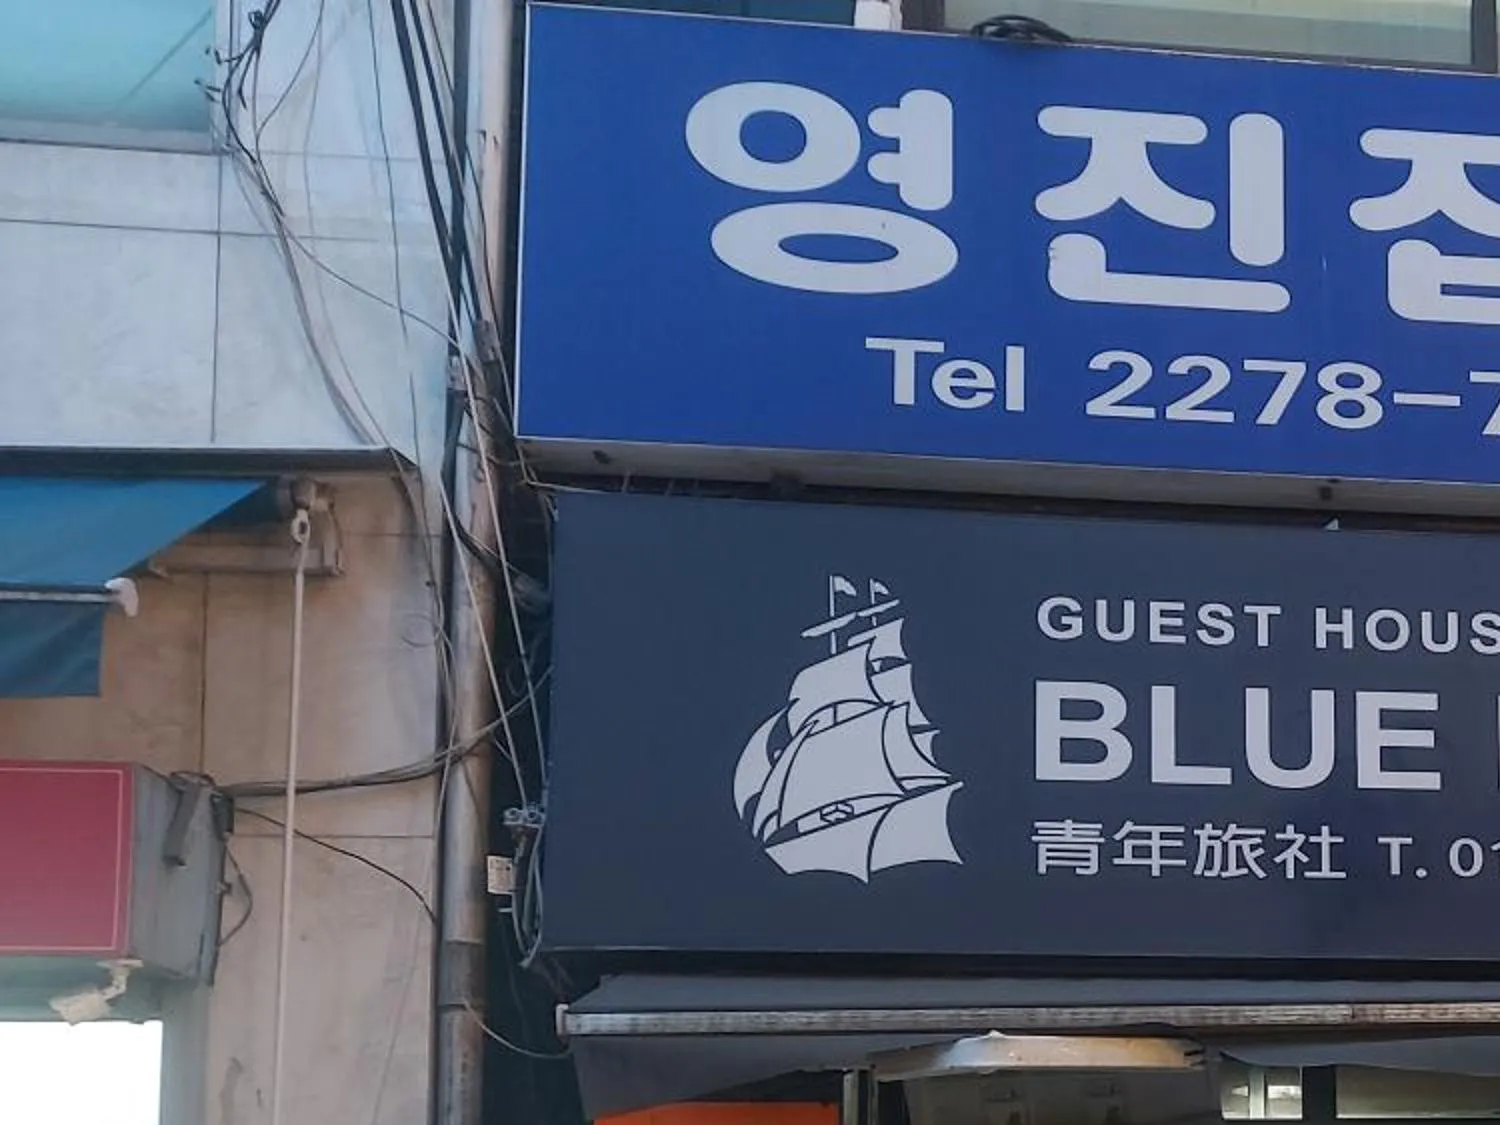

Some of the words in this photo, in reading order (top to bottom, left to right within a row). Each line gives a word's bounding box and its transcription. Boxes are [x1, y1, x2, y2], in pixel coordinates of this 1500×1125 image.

[865, 337, 1026, 415] Tel
[1036, 596, 1282, 648] GUEST
[1034, 679, 1442, 791] BLUE
[1030, 818, 1348, 882] 青年旅社
